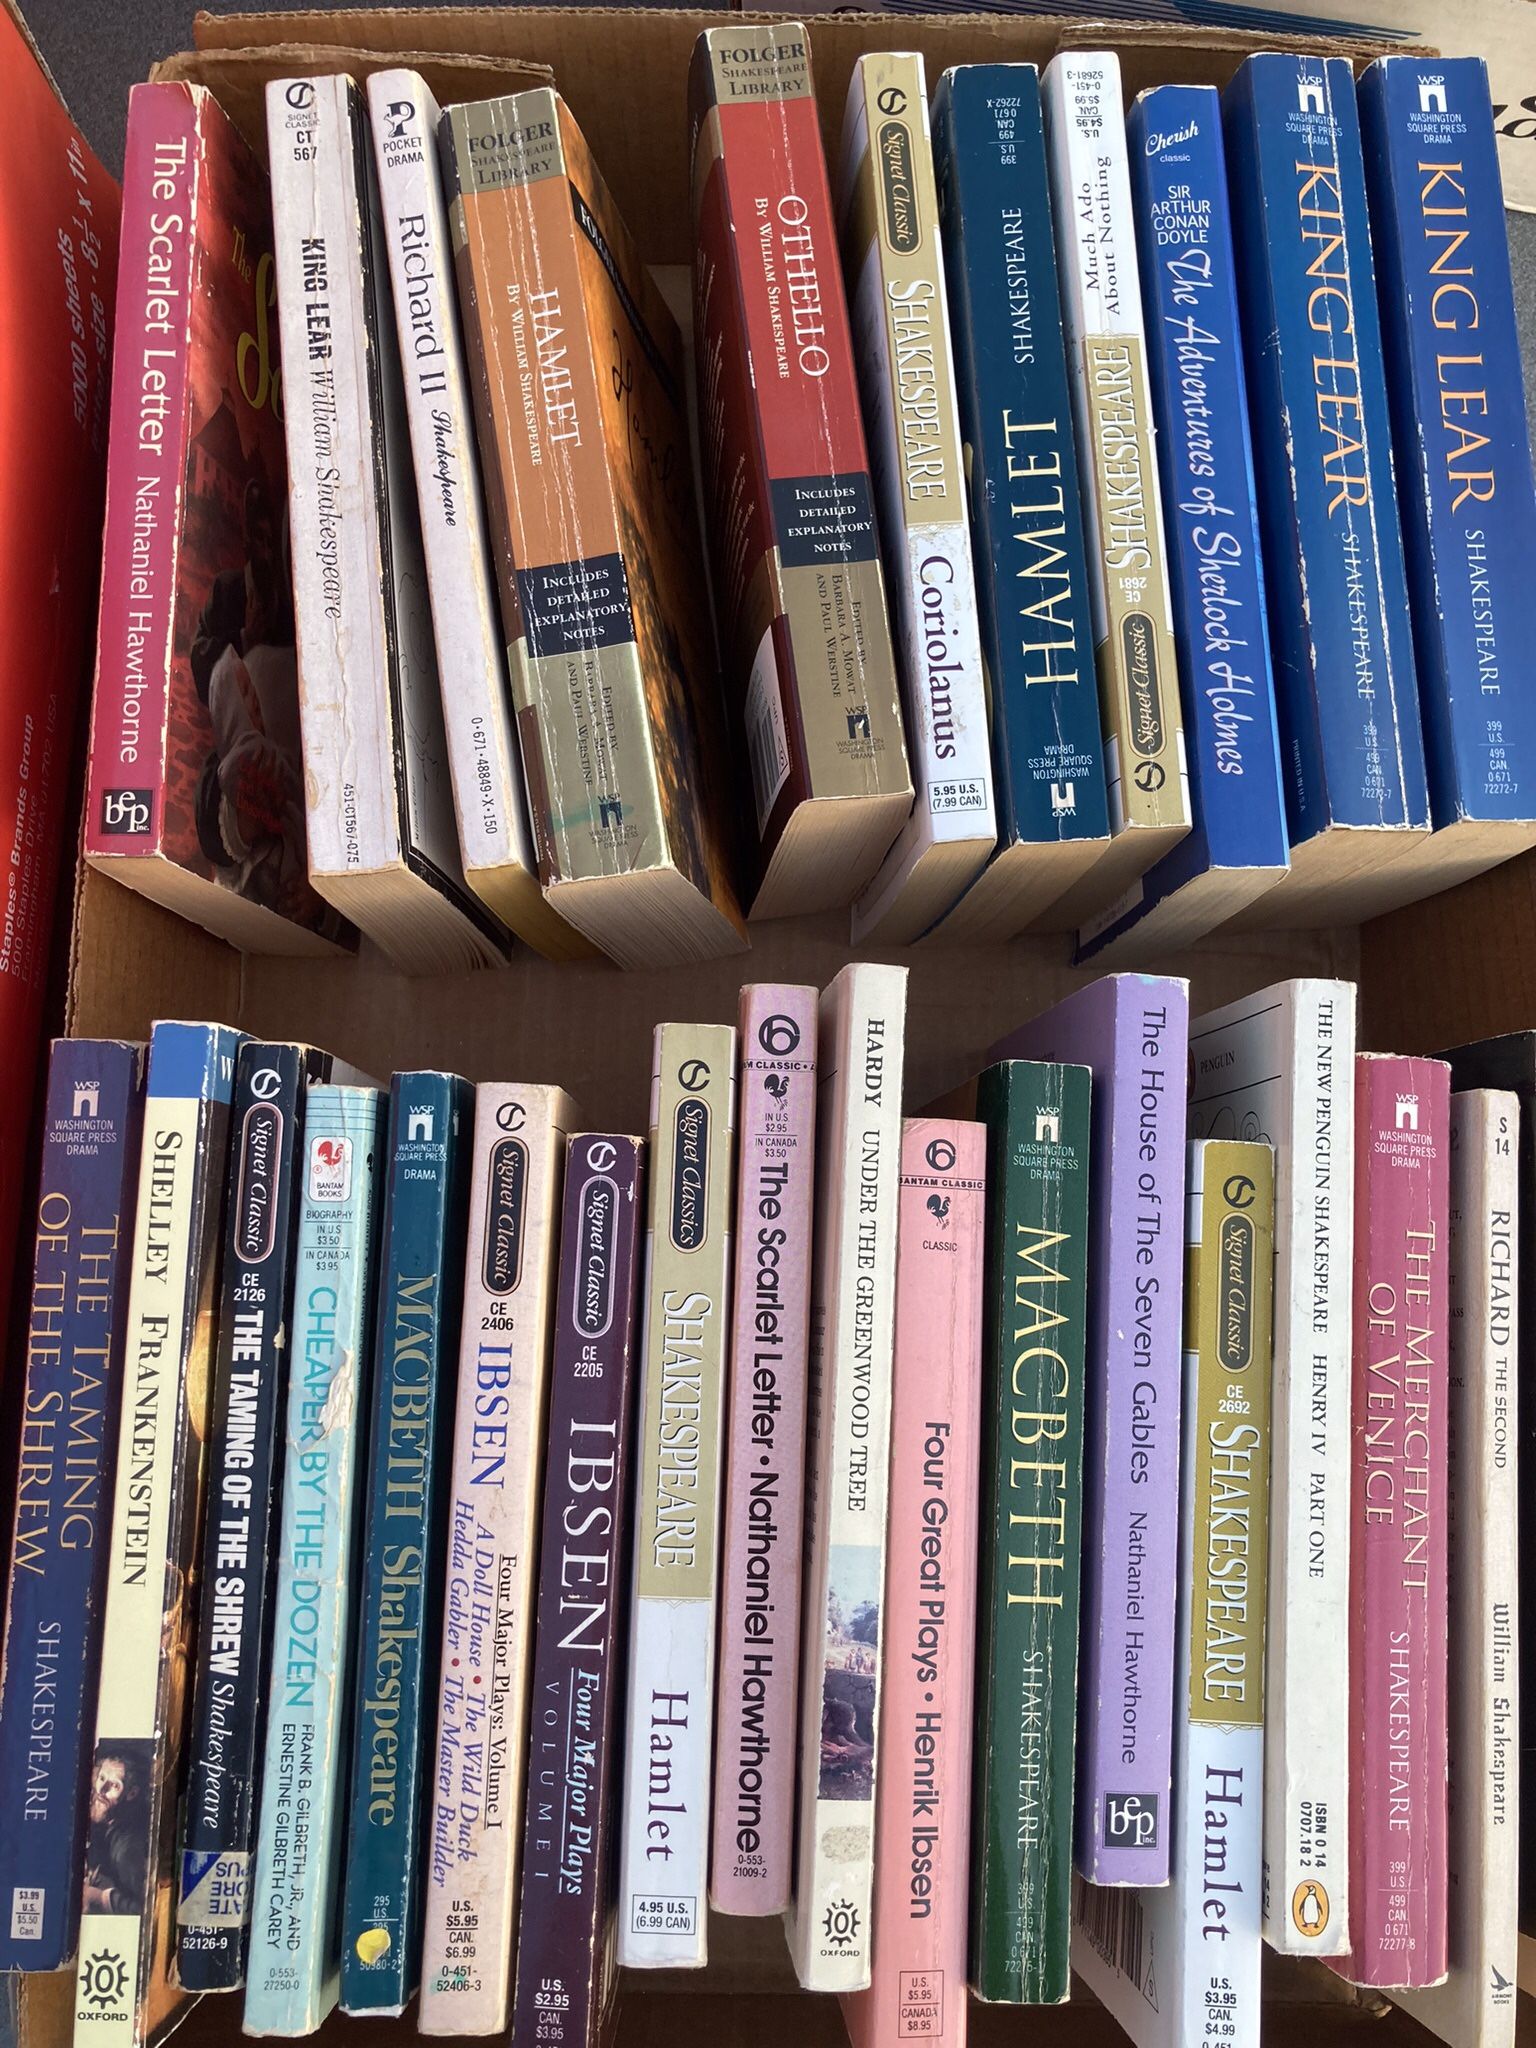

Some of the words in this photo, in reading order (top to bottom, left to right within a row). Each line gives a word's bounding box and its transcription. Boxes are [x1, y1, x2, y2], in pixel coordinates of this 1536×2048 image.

[719, 43, 806, 64] FOLGER
[293, 146, 318, 161] 567
[296, 131, 312, 144] CT
[383, 137, 423, 152] POCKET
[468, 122, 553, 153] FOLGER
[1145, 121, 1199, 156] Cherish
[1160, 154, 1190, 162] classic
[1407, 123, 1437, 132] SQUARE
[1441, 124, 1466, 133] PRESS
[1410, 113, 1461, 122] WASHINGTON
[1424, 134, 1452, 143] DRAMA
[152, 137, 187, 200] The
[387, 152, 424, 168] DRAMA
[1095, 157, 1113, 243] Nothing
[1168, 186, 1191, 198] SIR
[1077, 183, 1094, 223] Ado
[1150, 201, 1211, 215] ARTHUR
[1154, 215, 1209, 230] CONAN
[1158, 230, 1208, 245] DOYLE
[58, 228, 85, 340] sheets
[145, 214, 183, 333] Scarlet
[300, 238, 328, 292] KING
[777, 195, 830, 376] OTHELLO
[1002, 207, 1035, 363] SHAKESPEARE
[1084, 234, 1099, 290] Much
[1103, 256, 1120, 315] About
[1167, 248, 1213, 305] The
[1295, 160, 1354, 334] KING
[1418, 160, 1479, 330] KING
[400, 213, 443, 360] Richard
[303, 303, 332, 360] LEAR
[528, 288, 583, 447] HAMLET
[138, 349, 176, 457] Letter
[309, 369, 337, 457] William
[420, 370, 447, 395] II
[887, 279, 948, 501] SHAKESPEARE
[1165, 316, 1221, 477] Adventures
[431, 408, 457, 527] Shakespeare
[1092, 346, 1152, 569] SHAKESPEARE
[1312, 354, 1369, 520] LEAR
[1437, 354, 1496, 516] LEAR
[130, 476, 161, 599] Nathaniel
[1179, 486, 1234, 516] of
[314, 468, 343, 619] Shakespeare
[1003, 409, 1078, 687] HAMLET
[1193, 526, 1242, 653] Sherlock
[1341, 532, 1376, 699] SHAKESPEARE
[1465, 529, 1501, 696] SHAKESPEARE
[120, 612, 152, 763] Hawthorne
[919, 556, 964, 759] Coriolanus
[1208, 661, 1256, 776] Holmes
[11, 787, 27, 866] Brands
[20, 715, 33, 780] Group
[933, 796, 957, 809] (7.99
[959, 794, 983, 807] CAN)
[934, 787, 957, 798] 5.95
[960, 785, 979, 796] U.S.
[1142, 1007, 1167, 1057] The
[1318, 1000, 1332, 1038] THE
[864, 1018, 885, 1108] HARDY
[1316, 1047, 1331, 1092] NEW
[50, 1132, 85, 1142] SQUARE
[87, 1132, 117, 1143] PRESS
[55, 1119, 113, 1131] WASHINGTON
[67, 1144, 99, 1155] DRAMA
[679, 1105, 703, 1161] Signet
[1140, 1070, 1164, 1162] House
[1315, 1098, 1331, 1189] PENGUIN
[1495, 1138, 1510, 1156] 14
[144, 1130, 183, 1284] SHELLEY
[404, 1170, 436, 1180] DRAMA
[680, 1167, 702, 1246] Classics
[759, 1163, 788, 1220] The
[860, 1130, 880, 1214] UNDER
[942, 1180, 983, 1189] CLASSIC
[1138, 1173, 1161, 1205] of
[38, 1192, 71, 1253] OF
[858, 1219, 876, 1269] THE
[923, 1240, 957, 1252] CLASSIC
[1136, 1211, 1160, 1265] The
[1405, 1222, 1436, 1305] THE
[76, 1215, 120, 1315] THE
[233, 1288, 266, 1302] 2126
[755, 1228, 786, 1345] Scarlet
[1313, 1195, 1330, 1333] SHAKESPEARE
[1490, 1209, 1510, 1346] RICHARD
[28, 1271, 67, 1369] THE
[231, 1312, 264, 1361] THE
[482, 1318, 513, 1330] 2406
[1134, 1276, 1158, 1368] Seven
[1368, 1283, 1397, 1337] OF
[301, 1287, 337, 1442] CHEAPER
[385, 1273, 436, 1520] MACBETH
[574, 1363, 603, 1377] 2205
[851, 1276, 874, 1440] GREENWOOD
[1312, 1354, 1327, 1429] HENRY
[1496, 1357, 1507, 1392] THE
[60, 1333, 111, 1551] TAMING
[225, 1369, 260, 1468] TAMING
[470, 1342, 513, 1489] IBSEN
[653, 1290, 712, 1568] SHAKESPEARE
[752, 1353, 782, 1449] Letter
[1007, 1222, 1072, 1608] MACBETH
[1130, 1381, 1157, 1484] Gables
[1219, 1400, 1250, 1414] 2692
[1365, 1350, 1400, 1525] VENICE
[1494, 1397, 1507, 1468] SECOND
[14, 1390, 63, 1576] SHREW
[121, 1314, 170, 1587] FRANKENSTEIN
[299, 1452, 328, 1496] BY
[848, 1446, 867, 1512] TREE
[924, 1422, 950, 1490] Four
[1312, 1433, 1326, 1456] IV
[1402, 1323, 1435, 1597] MERCHANT
[222, 1475, 252, 1508] OF
[1310, 1473, 1325, 1526] PART
[217, 1516, 249, 1569] THE
[294, 1503, 326, 1569] THE
[557, 1418, 616, 1655] IBSEN
[744, 1473, 779, 1645] Nathaniel
[921, 1498, 948, 1592] Great
[1127, 1512, 1148, 1620] Nathaniel
[1204, 1421, 1260, 1702] SHAKESPEARE
[1309, 1531, 1323, 1578] ONE
[209, 1576, 245, 1676] SHREW
[285, 1581, 321, 1707] DOZEN
[911, 1601, 944, 1683] Plays
[24, 1622, 61, 1822] SHAKESPEARE
[364, 1545, 423, 1826] Shakespeare
[575, 1669, 600, 1731] Four
[1122, 1631, 1143, 1764] Hawthorne
[200, 1679, 235, 1829] Shakespeare
[737, 1655, 772, 1853] Hawthorne
[912, 1713, 941, 1816] Henrik
[1017, 1651, 1043, 1849] SHAKESPEARE
[1389, 1633, 1410, 1832] SHAKESPEARE
[567, 1738, 597, 1817] Major
[647, 1689, 689, 1861] Hamlet
[1202, 1764, 1243, 1941] Hamlet
[1315, 1803, 1327, 1833] ISBN
[559, 1824, 591, 1896] Plays
[910, 1828, 938, 1919] Ibsen
[446, 1916, 478, 1926] $5.95
[636, 1917, 663, 1929] (6.99
[666, 1917, 690, 1929] CAN)
[639, 1902, 663, 1913] 4.95
[667, 1903, 688, 1914] U.S.
[446, 1947, 476, 1958] $6.99
[820, 1949, 860, 1957] OXFORD
[77, 2012, 128, 2022] OXFORD
